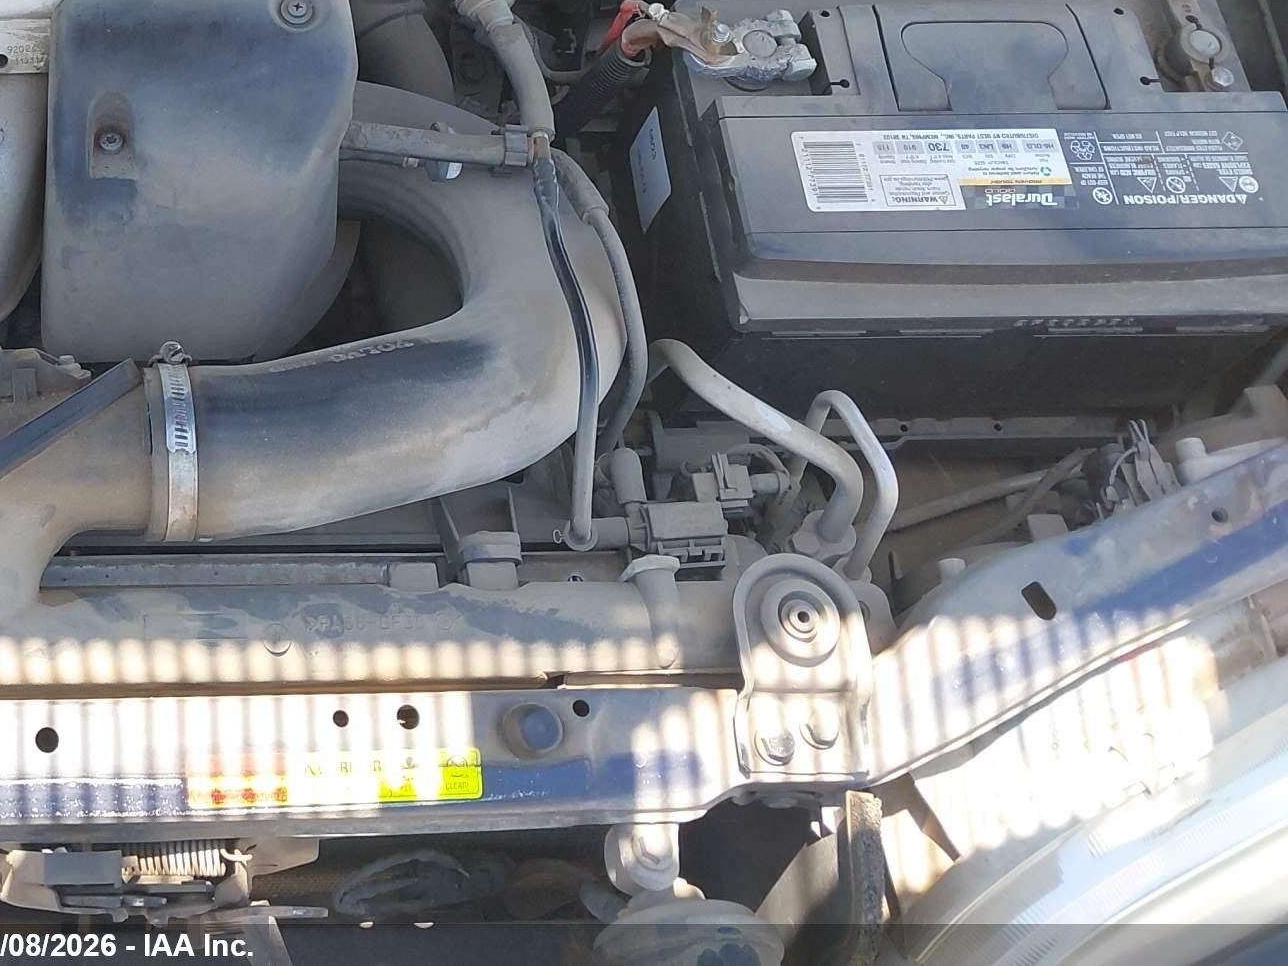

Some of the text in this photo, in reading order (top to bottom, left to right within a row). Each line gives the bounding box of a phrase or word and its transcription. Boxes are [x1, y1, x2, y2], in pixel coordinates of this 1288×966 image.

[928, 142, 950, 152] 730
[985, 193, 1058, 207] Duralast
[1123, 194, 1238, 205] DANGER/POISON
[329, 339, 416, 363] VOLVO
